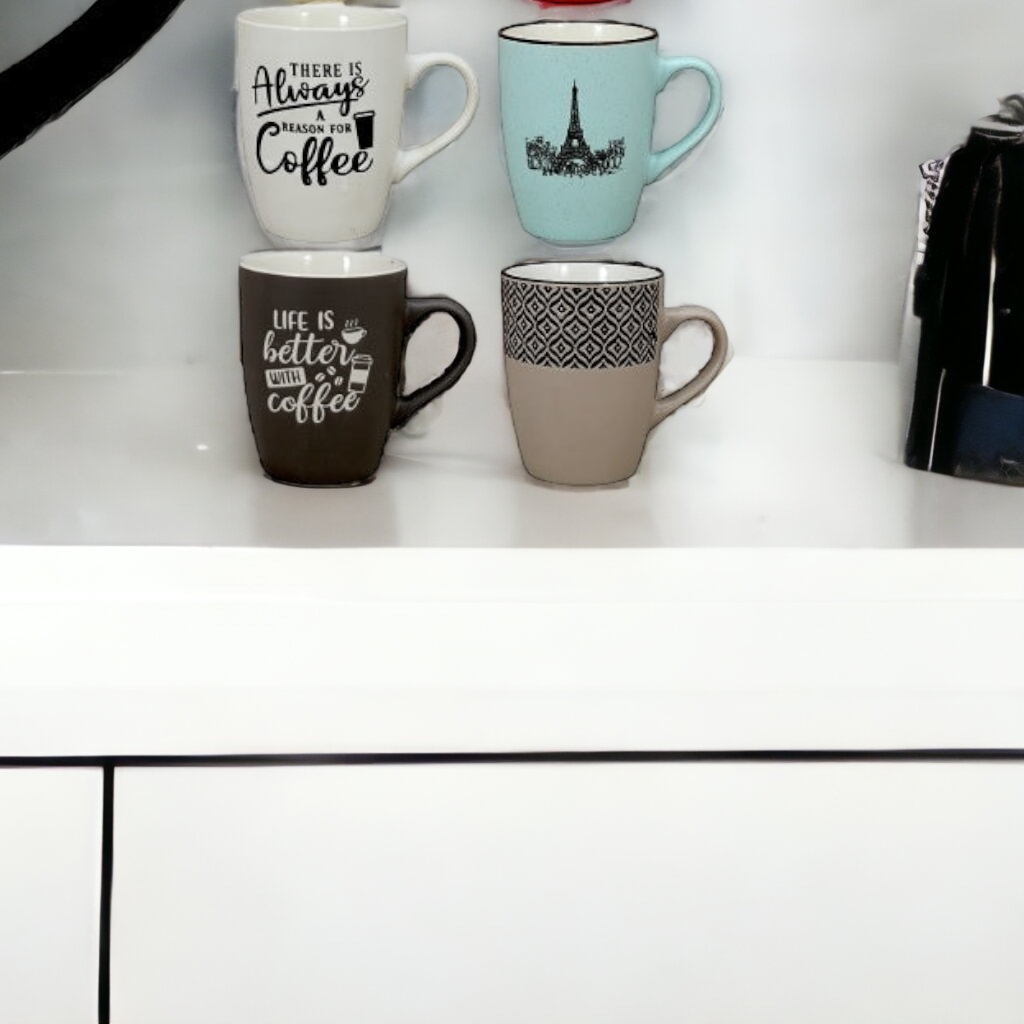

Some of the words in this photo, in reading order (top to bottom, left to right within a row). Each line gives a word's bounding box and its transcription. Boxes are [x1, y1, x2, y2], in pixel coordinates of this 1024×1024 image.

[289, 62, 343, 78] THERE
[349, 61, 363, 77] IS
[251, 65, 370, 117] Always
[315, 109, 326, 121] A
[282, 121, 325, 134] REASON
[330, 122, 353, 134] FOR
[256, 121, 374, 186] Coffee
[273, 309, 309, 331] LIFE
[317, 309, 335, 331] IS
[263, 330, 356, 366] better
[269, 370, 302, 386] WITH
[267, 382, 361, 424] coffee
